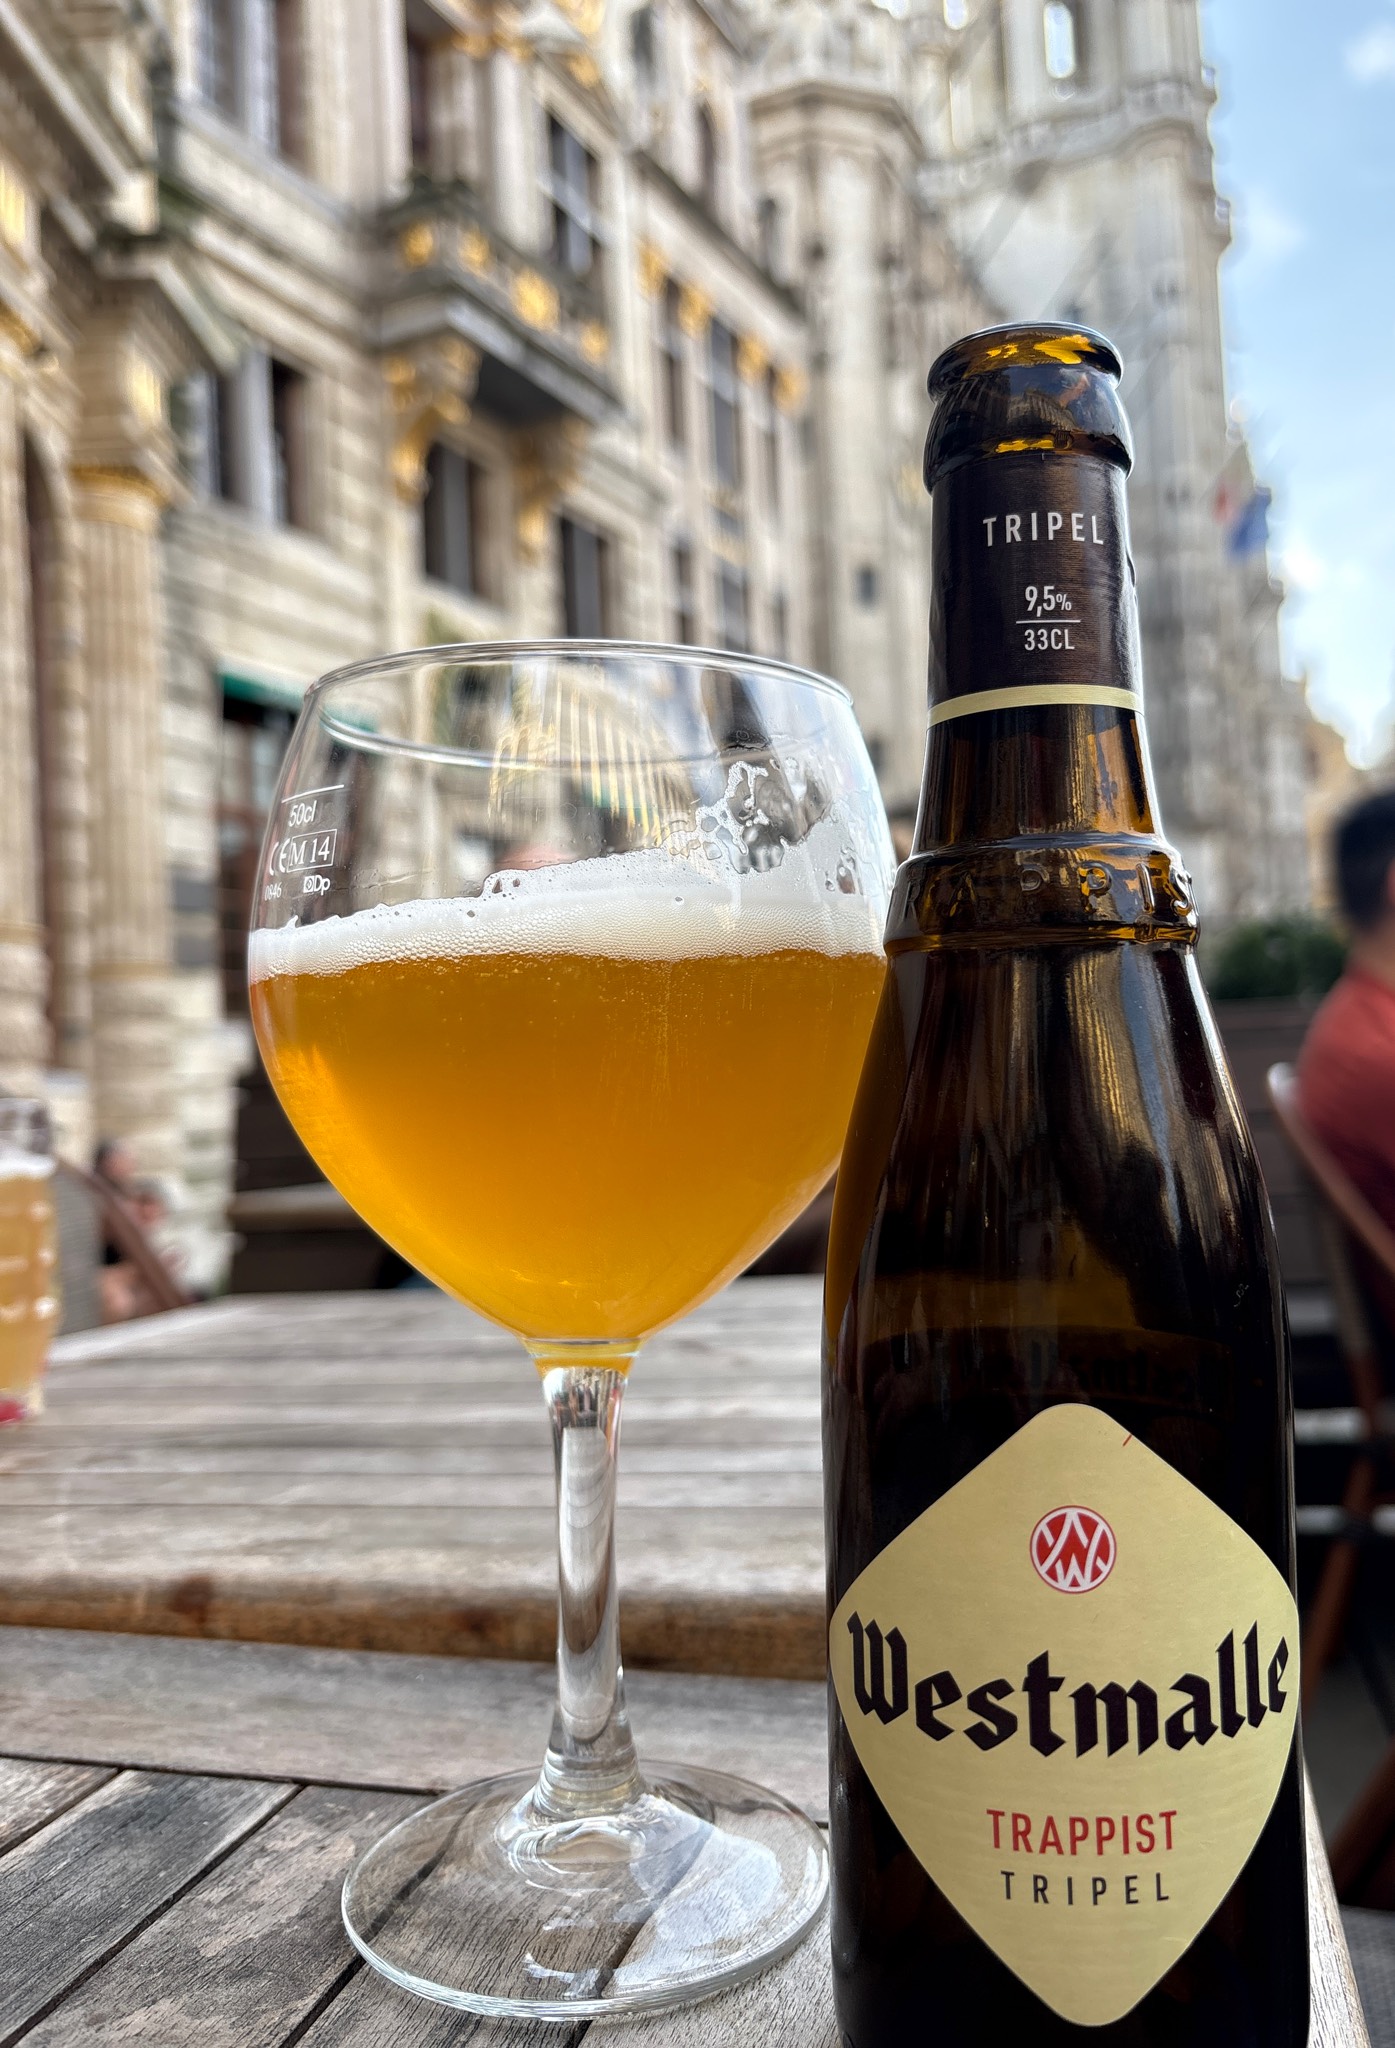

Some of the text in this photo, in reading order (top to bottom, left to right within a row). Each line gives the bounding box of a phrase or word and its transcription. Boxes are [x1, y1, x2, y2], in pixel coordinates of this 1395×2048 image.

[983, 512, 1104, 547] TRIPEL
[1025, 585, 1072, 617] 9,5%
[1024, 629, 1075, 651] 33CL
[288, 801, 316, 827] 50cl
[847, 1611, 1289, 1758] Westmalle
[986, 1809, 1177, 1856] TRAPPIST
[1000, 1870, 1169, 1906] TRIPEL
